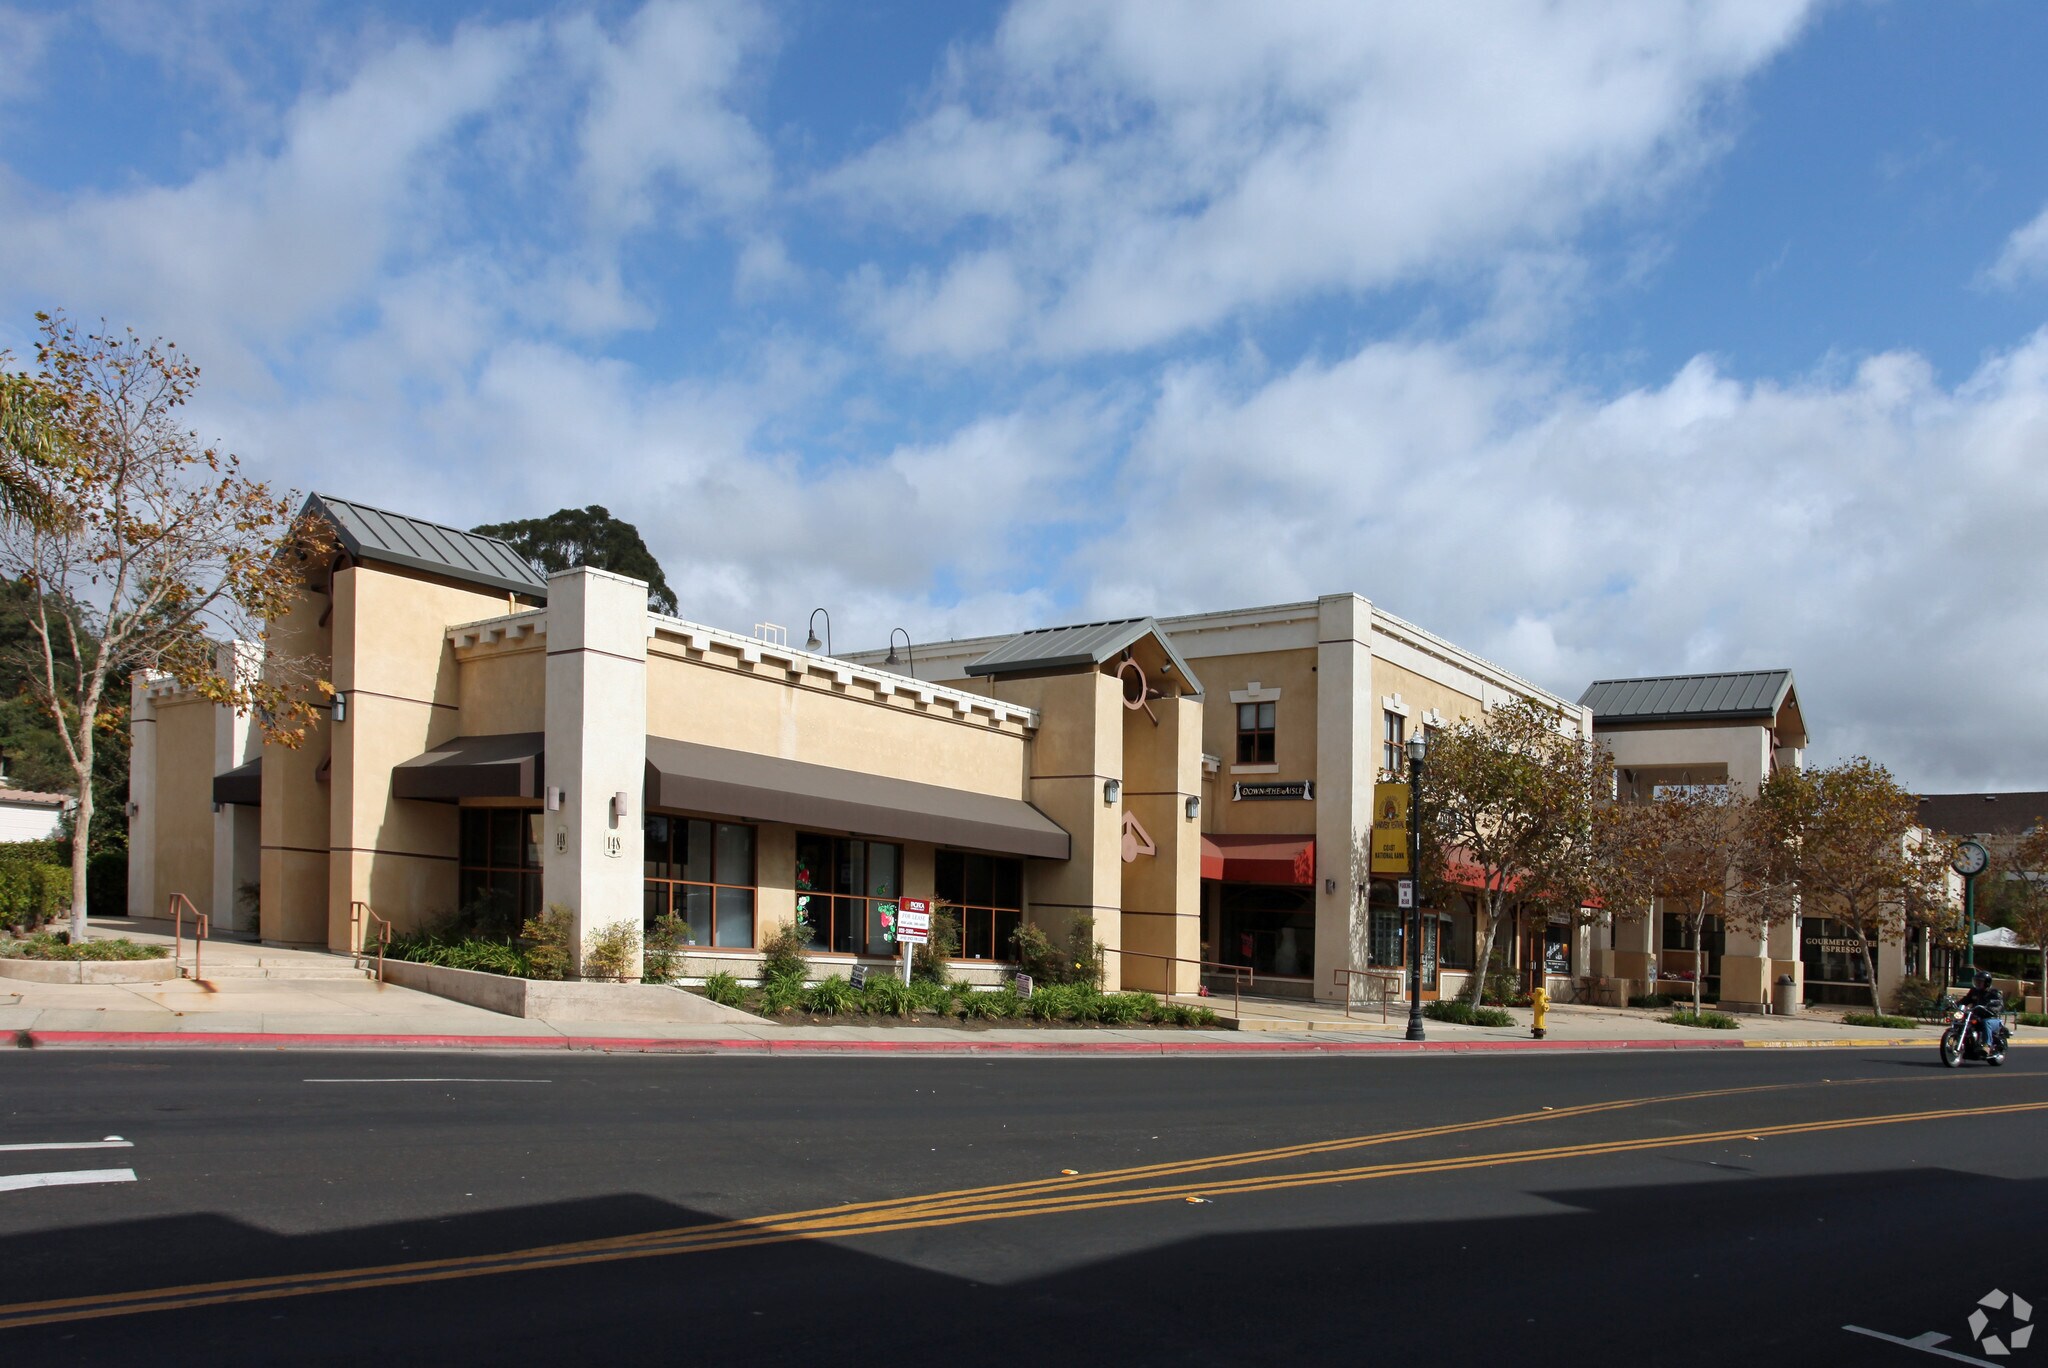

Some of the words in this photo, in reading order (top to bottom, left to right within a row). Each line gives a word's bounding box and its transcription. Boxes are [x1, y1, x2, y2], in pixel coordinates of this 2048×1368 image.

[1242, 787, 1264, 795] DOWN
[1265, 787, 1281, 795] THE
[1281, 787, 1302, 795] AISLE
[608, 836, 620, 850] 148
[1805, 937, 1846, 946] GOURMET
[1847, 939, 1877, 947] COEE
[1821, 945, 1862, 954] ESPRESSO
